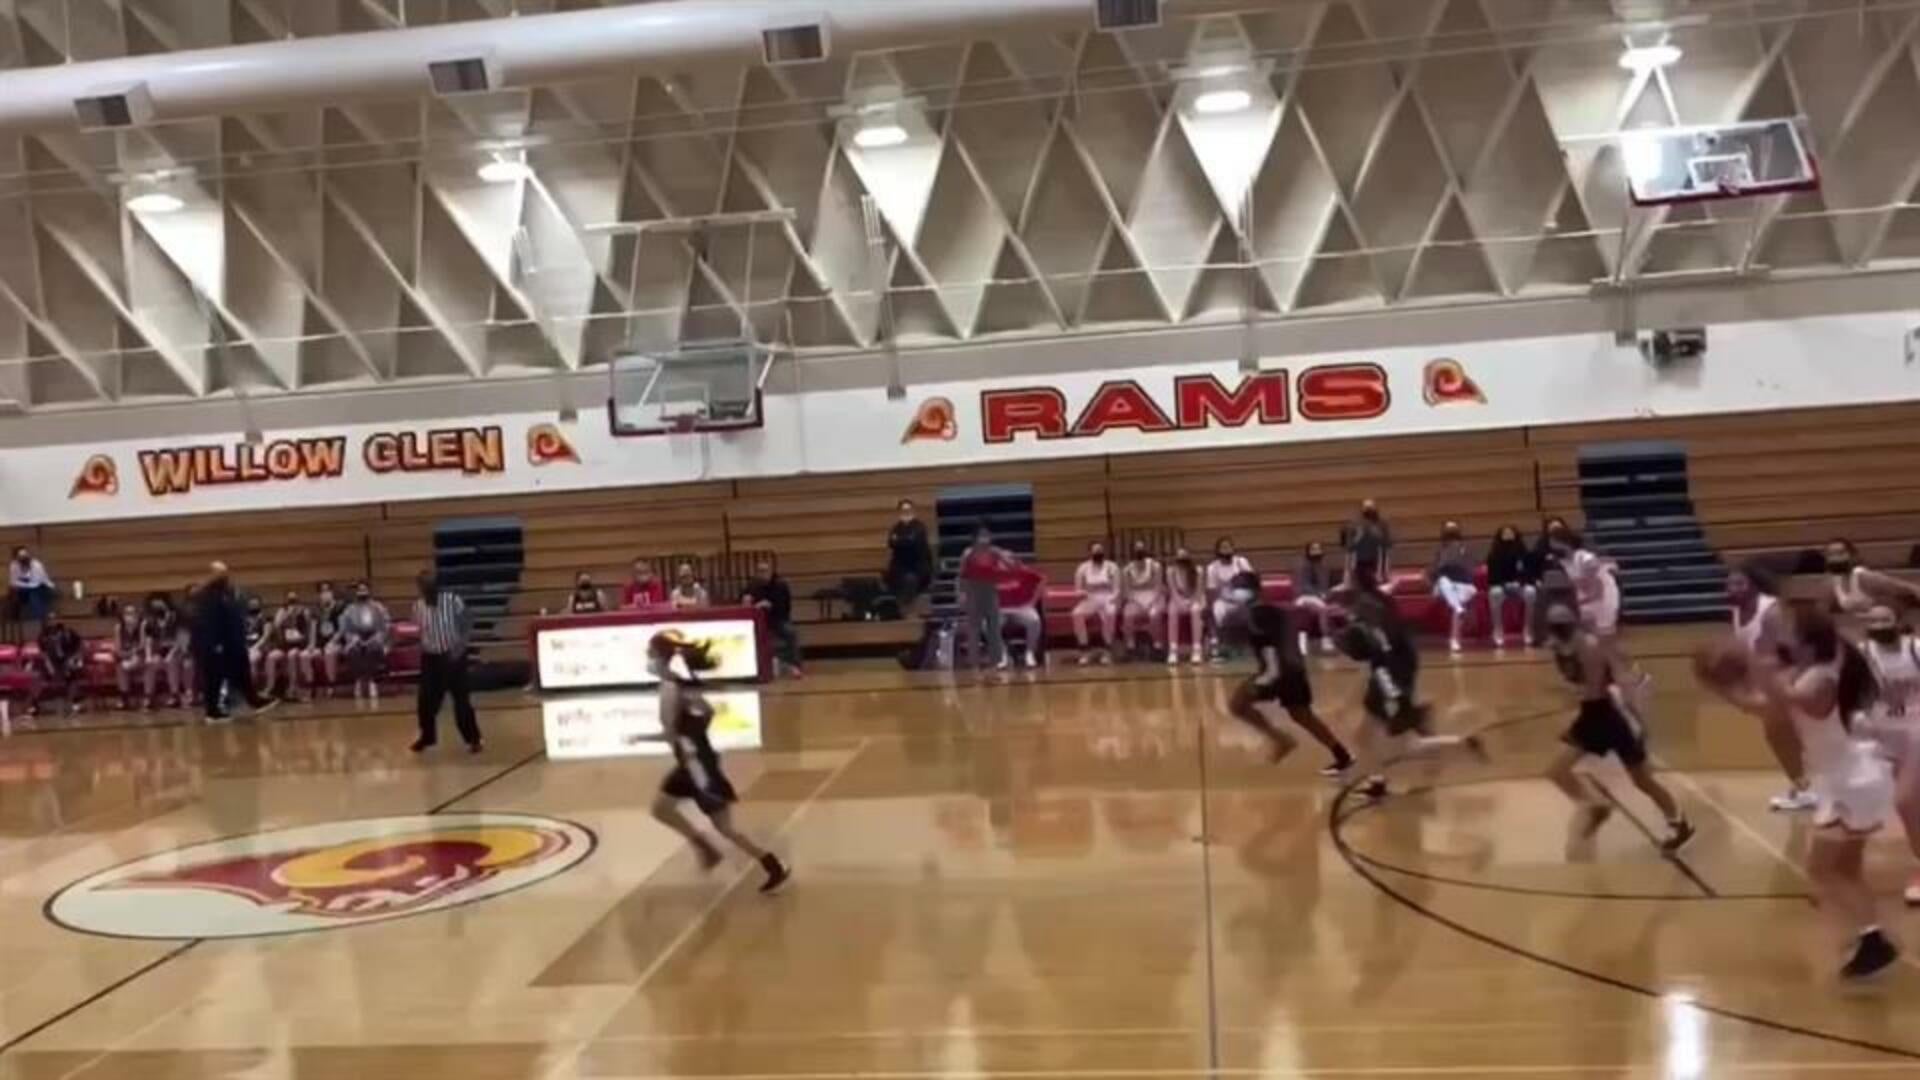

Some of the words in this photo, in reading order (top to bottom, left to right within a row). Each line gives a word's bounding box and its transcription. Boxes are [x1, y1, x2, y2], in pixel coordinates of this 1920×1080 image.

[981, 362, 1391, 443] RAMS
[138, 437, 346, 495] WILLOW
[364, 426, 504, 477] GLEN
